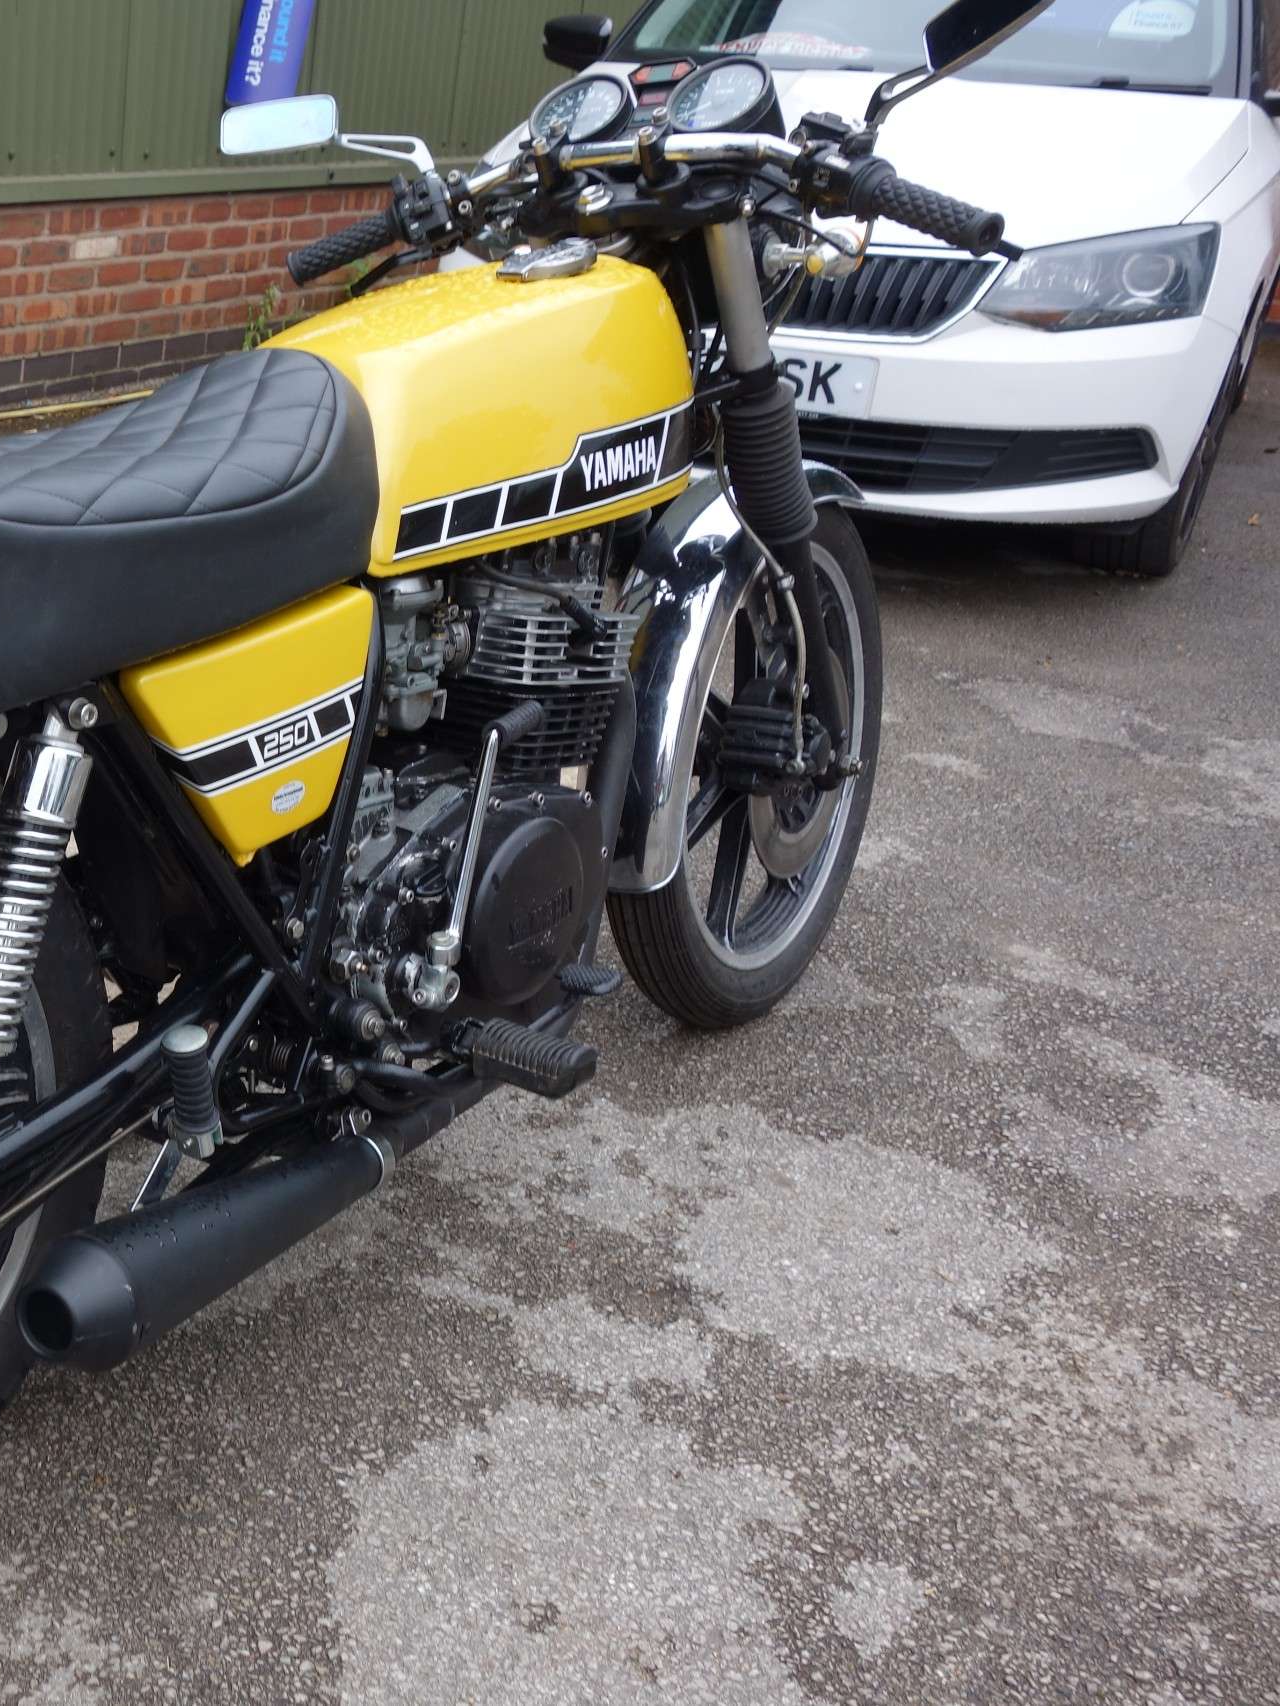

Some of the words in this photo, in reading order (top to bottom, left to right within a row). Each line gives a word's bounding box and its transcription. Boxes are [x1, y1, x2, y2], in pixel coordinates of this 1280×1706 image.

[244, 58, 264, 86] it?
[580, 435, 657, 492] YAMAHA
[263, 718, 309, 759] 250
